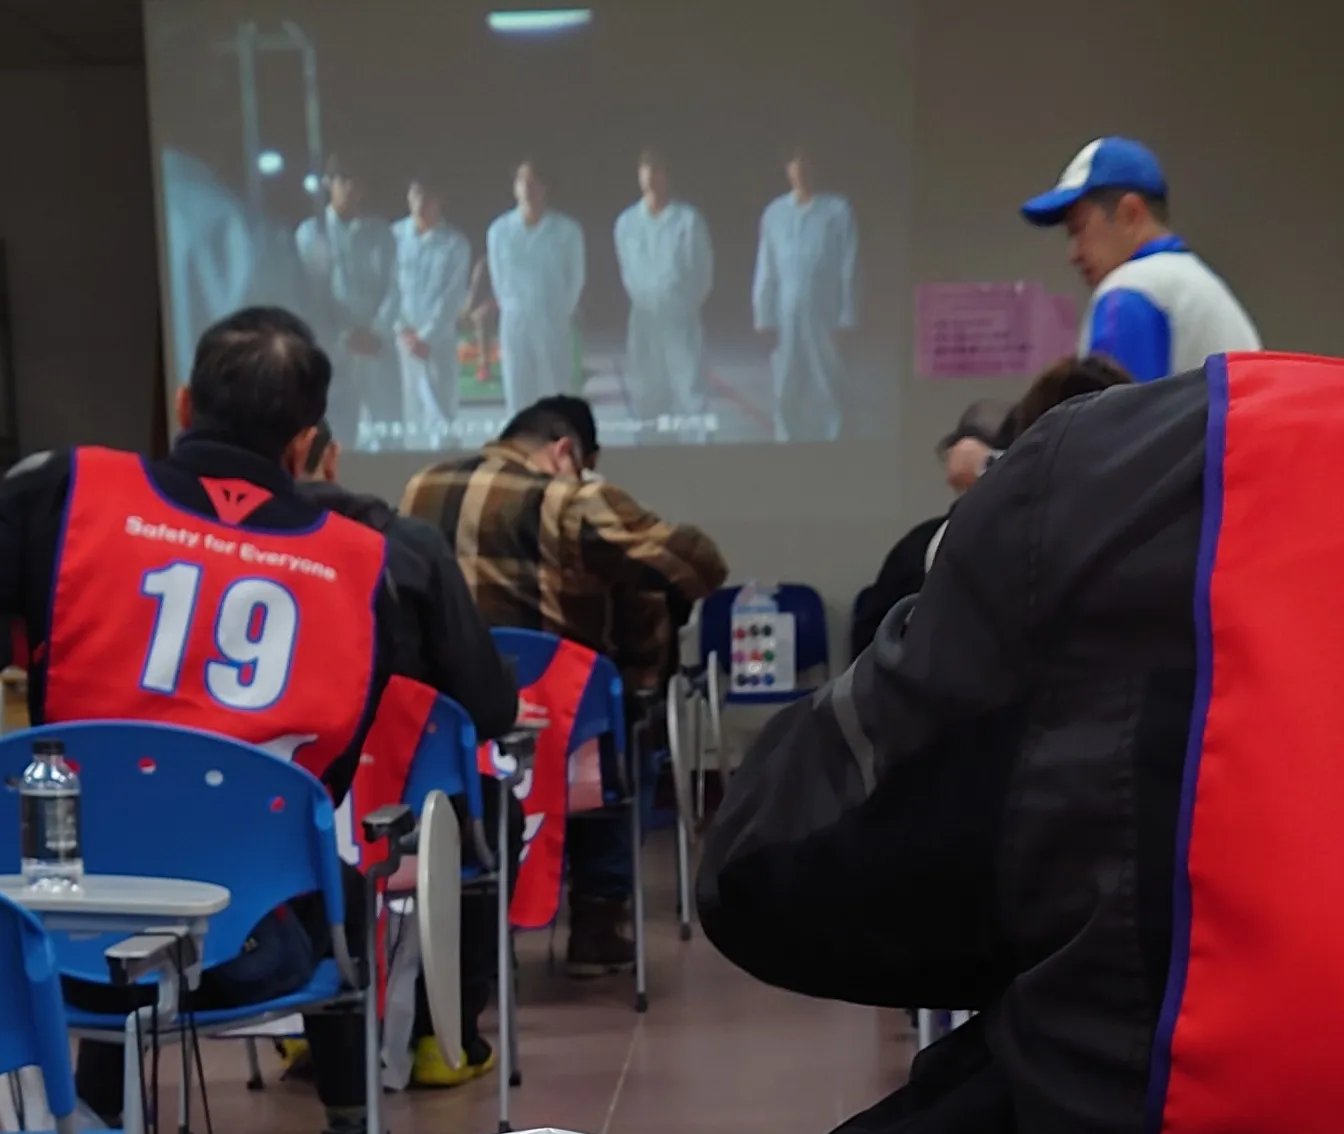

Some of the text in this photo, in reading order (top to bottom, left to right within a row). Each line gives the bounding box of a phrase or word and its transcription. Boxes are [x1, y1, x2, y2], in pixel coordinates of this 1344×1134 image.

[125, 515, 338, 583] Safety for Everyone
[140, 559, 300, 711] 19
